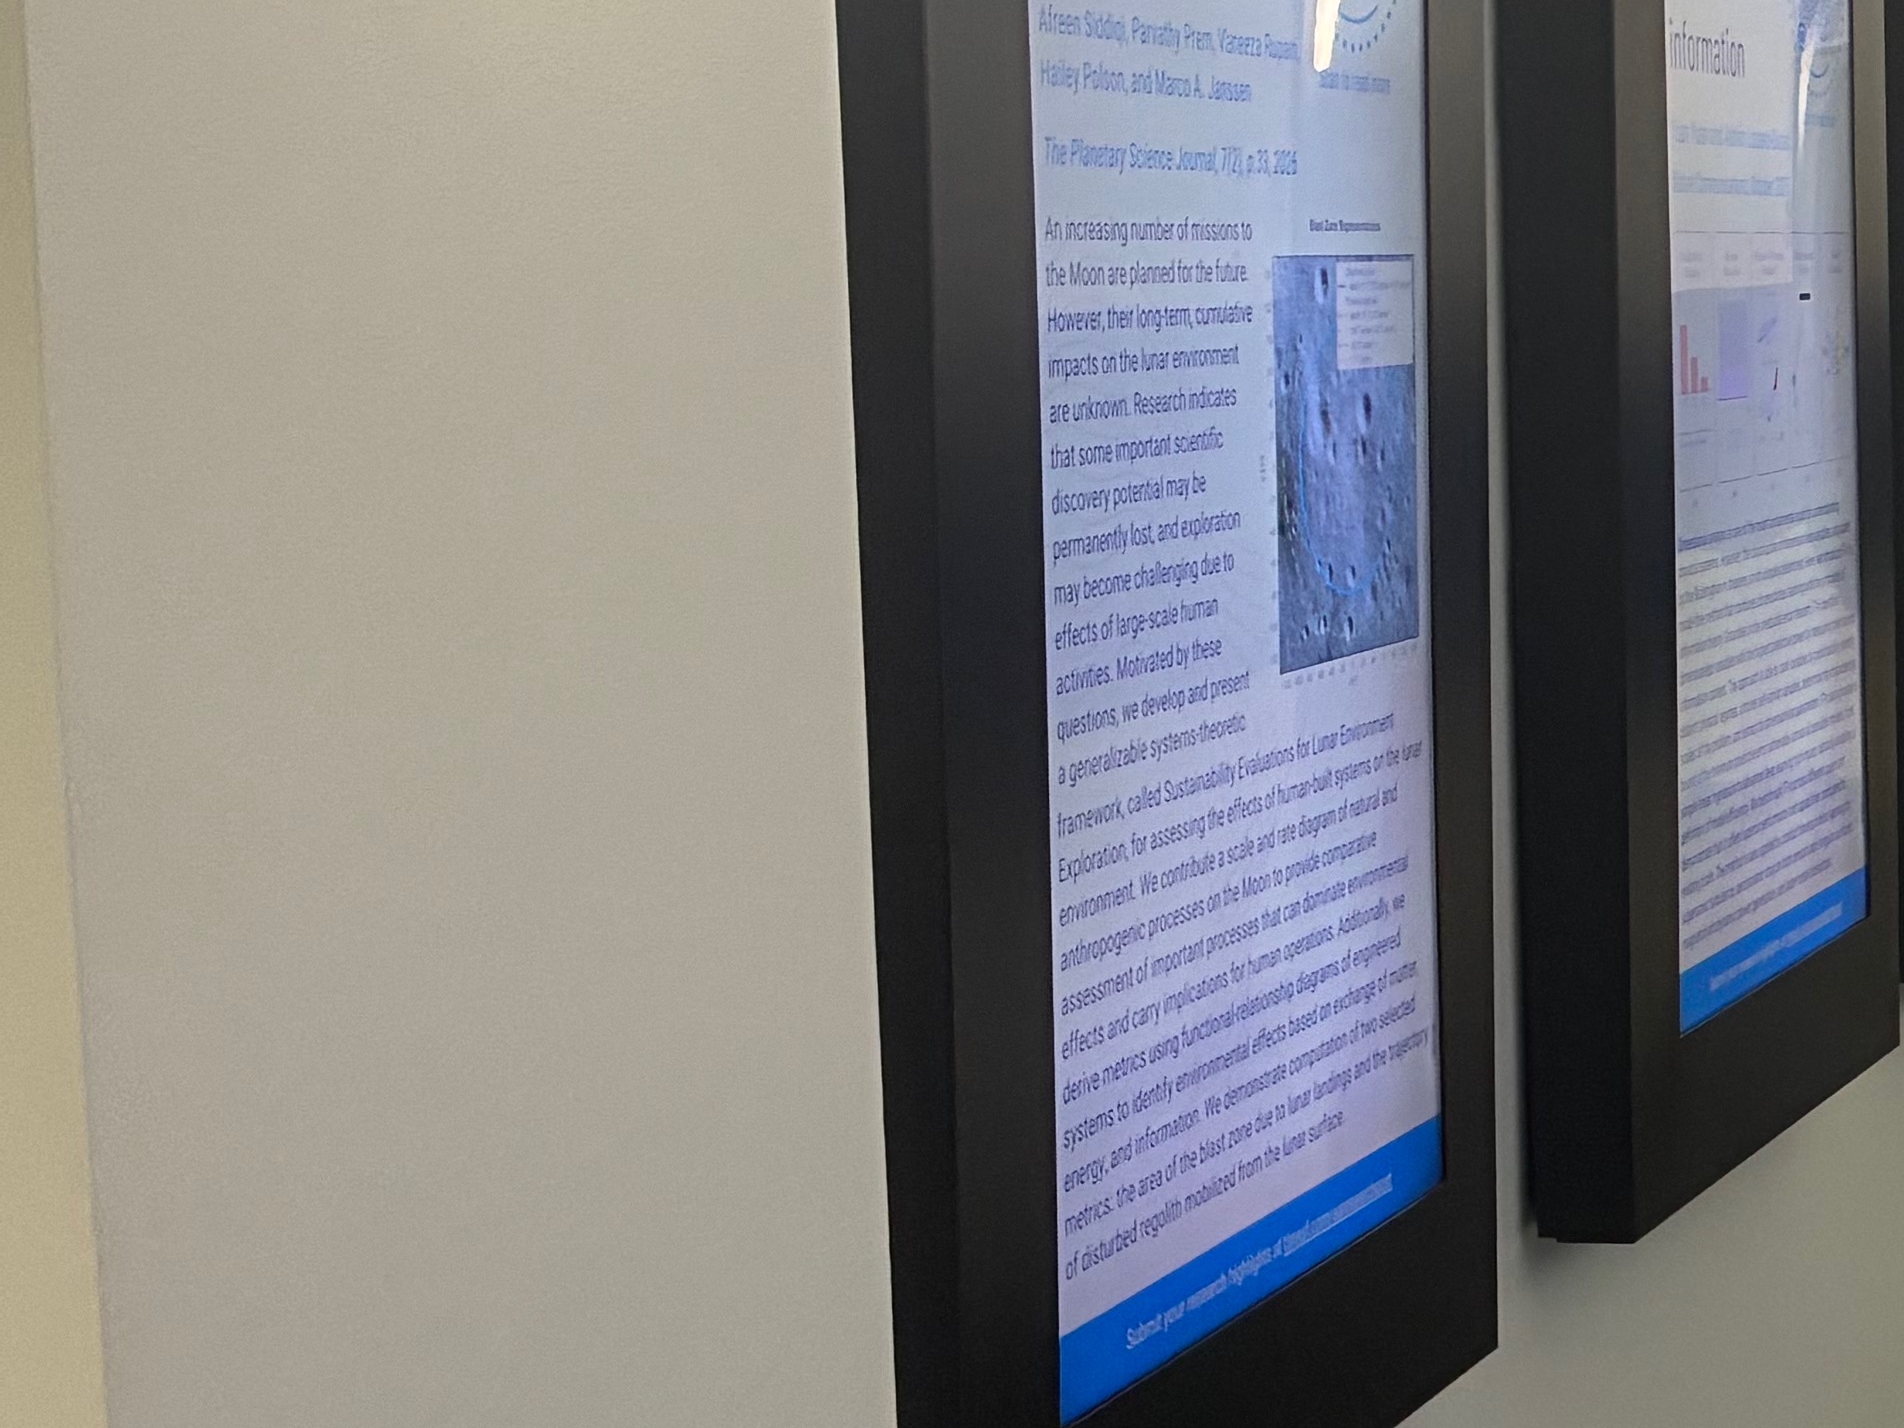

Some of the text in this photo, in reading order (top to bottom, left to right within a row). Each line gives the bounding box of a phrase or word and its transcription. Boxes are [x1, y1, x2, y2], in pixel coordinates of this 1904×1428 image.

[1668, 16, 1745, 78] information
[1130, 67, 1152, 94] and
[1043, 134, 1067, 167] The
[1044, 214, 1253, 247] An increasing number of missions to
[1045, 260, 1066, 287] the
[1069, 260, 1105, 287] Moon
[1107, 266, 1127, 286] are
[1129, 258, 1175, 291] planned
[1177, 258, 1192, 284] for
[1195, 258, 1212, 283] the
[1106, 302, 1133, 330] their
[1195, 298, 1253, 326] cumulative
[1047, 341, 1239, 383] impacts on the lunar environment
[1048, 404, 1069, 428] are
[1133, 386, 1186, 419] Research
[1188, 383, 1237, 414] indicates
[1049, 426, 1224, 469] that some important scientific
[1051, 471, 1207, 517] discovery potential may be
[1052, 525, 1128, 568] permanently
[1157, 516, 1178, 544] and
[1180, 509, 1241, 544] exploration
[1053, 549, 1235, 610] may become challenging due to
[1054, 599, 1219, 652] effects of large-scale human
[1116, 644, 1174, 681] Motivated
[1175, 641, 1189, 671] by
[1191, 637, 1223, 663] these
[1122, 701, 1138, 724] we
[1140, 686, 1185, 719] develop
[1187, 677, 1208, 706] and
[1210, 666, 1250, 706] present
[1057, 709, 1247, 789] a generalizable systems-theoretic
[1127, 779, 1161, 814] called
[1163, 758, 1235, 802] Sustainability
[1130, 831, 1147, 858] for
[1150, 812, 1205, 851] assessing
[1139, 868, 1158, 895] We
[1160, 848, 1215, 887] contribute
[1060, 917, 1145, 972] anthropogenic
[1147, 898, 1204, 943] processes
[1061, 963, 1133, 1017] assessment
[1135, 957, 1148, 985] of
[1151, 934, 1203, 979] important
[1061, 1019, 1104, 1059] effects
[1107, 1005, 1129, 1039] and
[1131, 998, 1160, 1028] carry
[1162, 969, 1228, 1014] implications
[1062, 1069, 1099, 1104] derive
[1102, 1047, 1146, 1086] metrics
[1148, 1032, 1179, 1064] using
[1063, 1106, 1114, 1152] systems
[1116, 1096, 1129, 1123] to
[1131, 1074, 1172, 1115] identify
[1110, 1135, 1132, 1169] and
[1116, 1180, 1135, 1207] the
[1138, 1168, 1162, 1196] area
[1164, 1155, 1177, 1182] of
[1179, 1148, 1197, 1174] the
[1065, 1247, 1078, 1282] of
[1081, 1215, 1137, 1273] disturbed
[1139, 1191, 1181, 1240] regolith
[1184, 1162, 1236, 1214] mobilized
